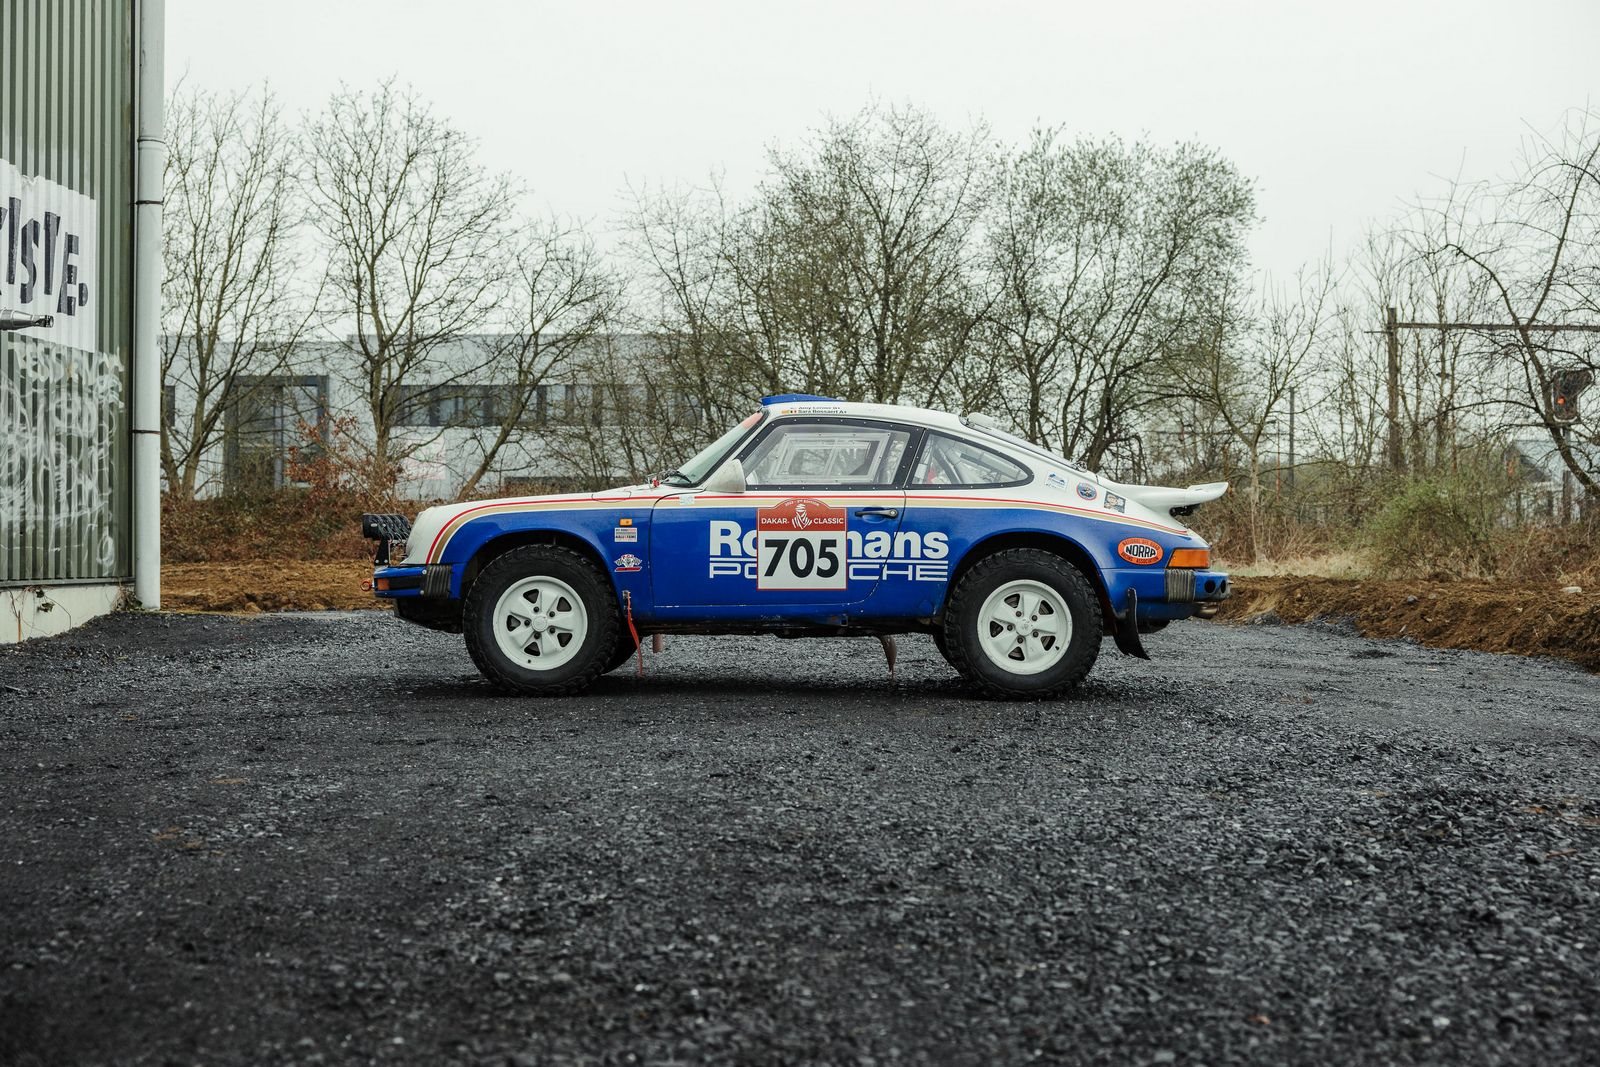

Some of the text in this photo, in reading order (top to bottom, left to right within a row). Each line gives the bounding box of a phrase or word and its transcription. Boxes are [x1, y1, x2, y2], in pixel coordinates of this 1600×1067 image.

[764, 537, 840, 578] 705
[1125, 544, 1157, 558] NORRA
[709, 562, 949, 582] PCHE
